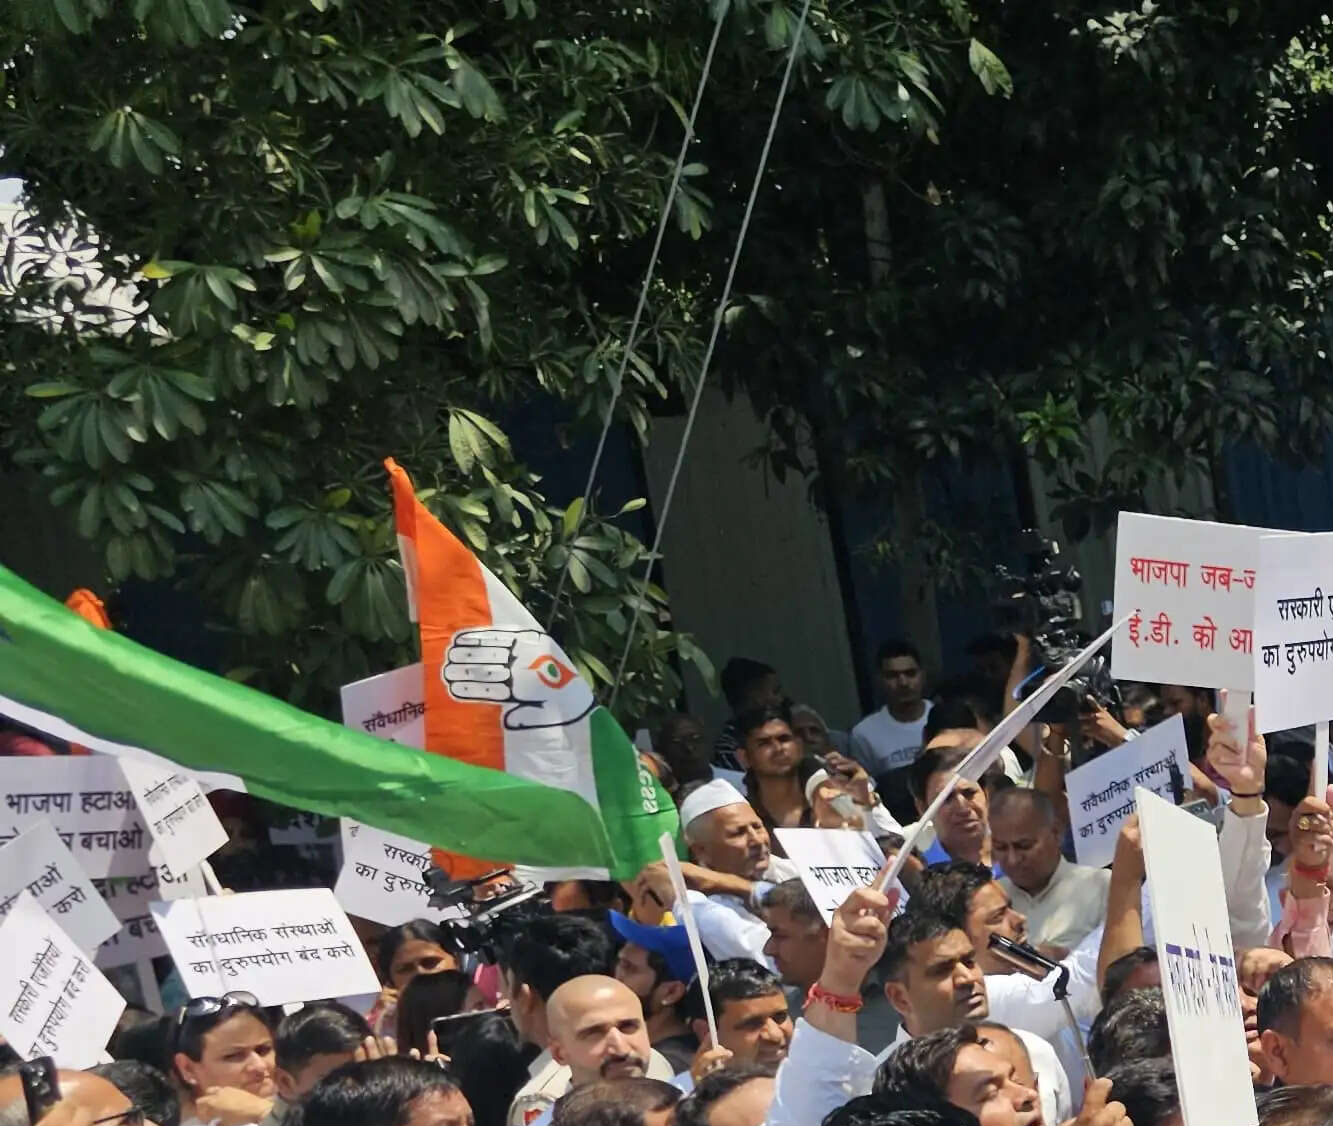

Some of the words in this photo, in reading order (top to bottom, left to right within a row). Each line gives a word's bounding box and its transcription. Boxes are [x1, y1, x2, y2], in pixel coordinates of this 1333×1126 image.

[1130, 557, 1190, 589] भाजपा
[1277, 587, 1323, 621] सरकारी
[1192, 616, 1217, 650] को
[1262, 644, 1280, 668] का
[6, 792, 72, 814] भाजपा
[79, 822, 143, 850] बचाओ
[1079, 823, 1093, 838] का
[355, 862, 378, 881] का
[809, 866, 857, 887] भाजपा
[52, 885, 86, 914] करो
[189, 960, 216, 975] का
[220, 948, 293, 976] दुरुपयोग
[296, 945, 321, 961] बंद
[324, 940, 354, 958] करो
